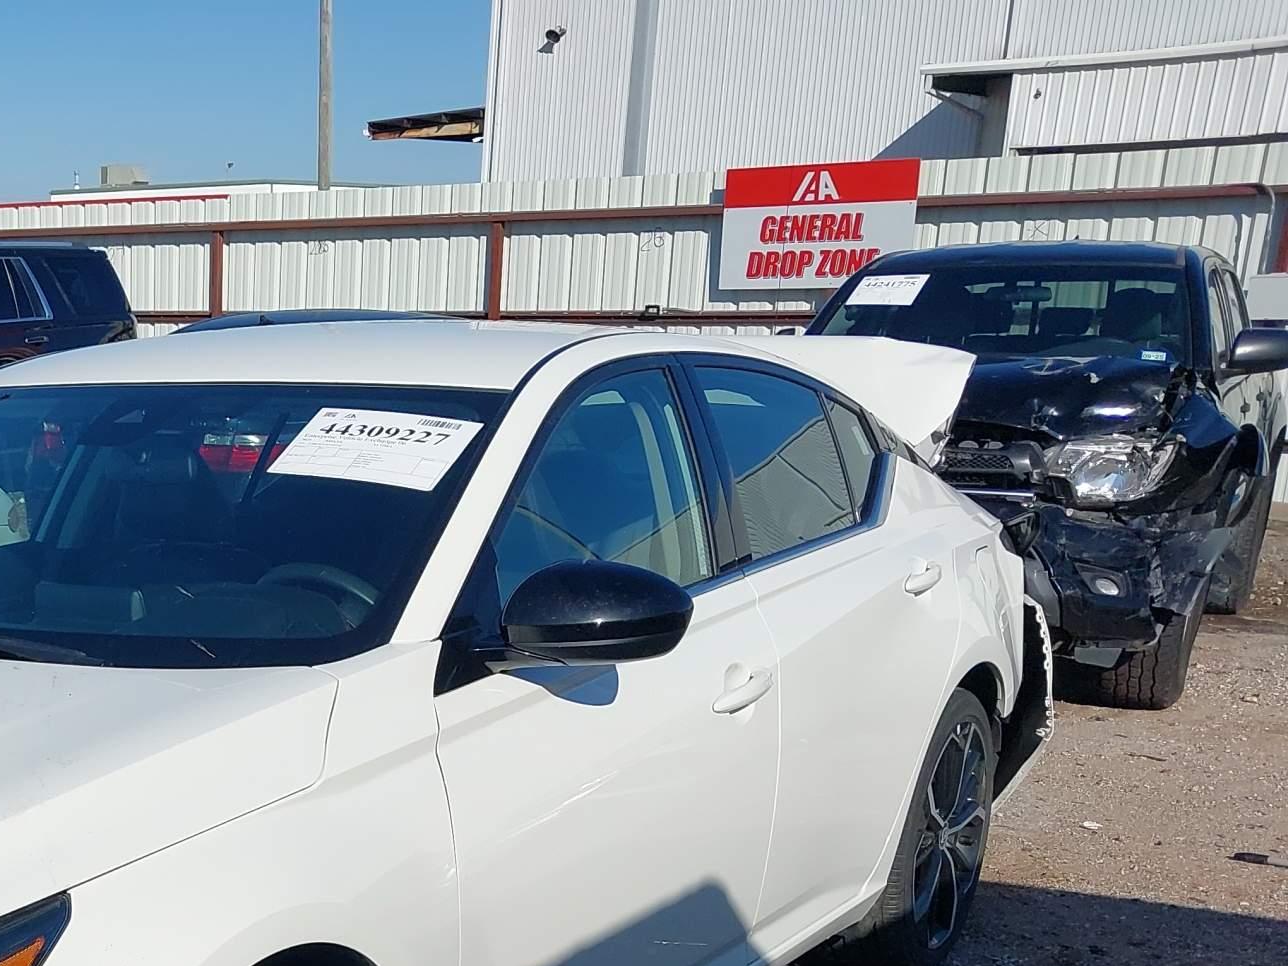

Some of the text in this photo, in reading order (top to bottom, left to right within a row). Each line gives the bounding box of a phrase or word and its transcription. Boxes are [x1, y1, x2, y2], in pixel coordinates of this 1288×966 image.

[759, 212, 864, 244] GENERAL
[745, 250, 814, 279] DROP
[319, 422, 452, 447] 44309227
